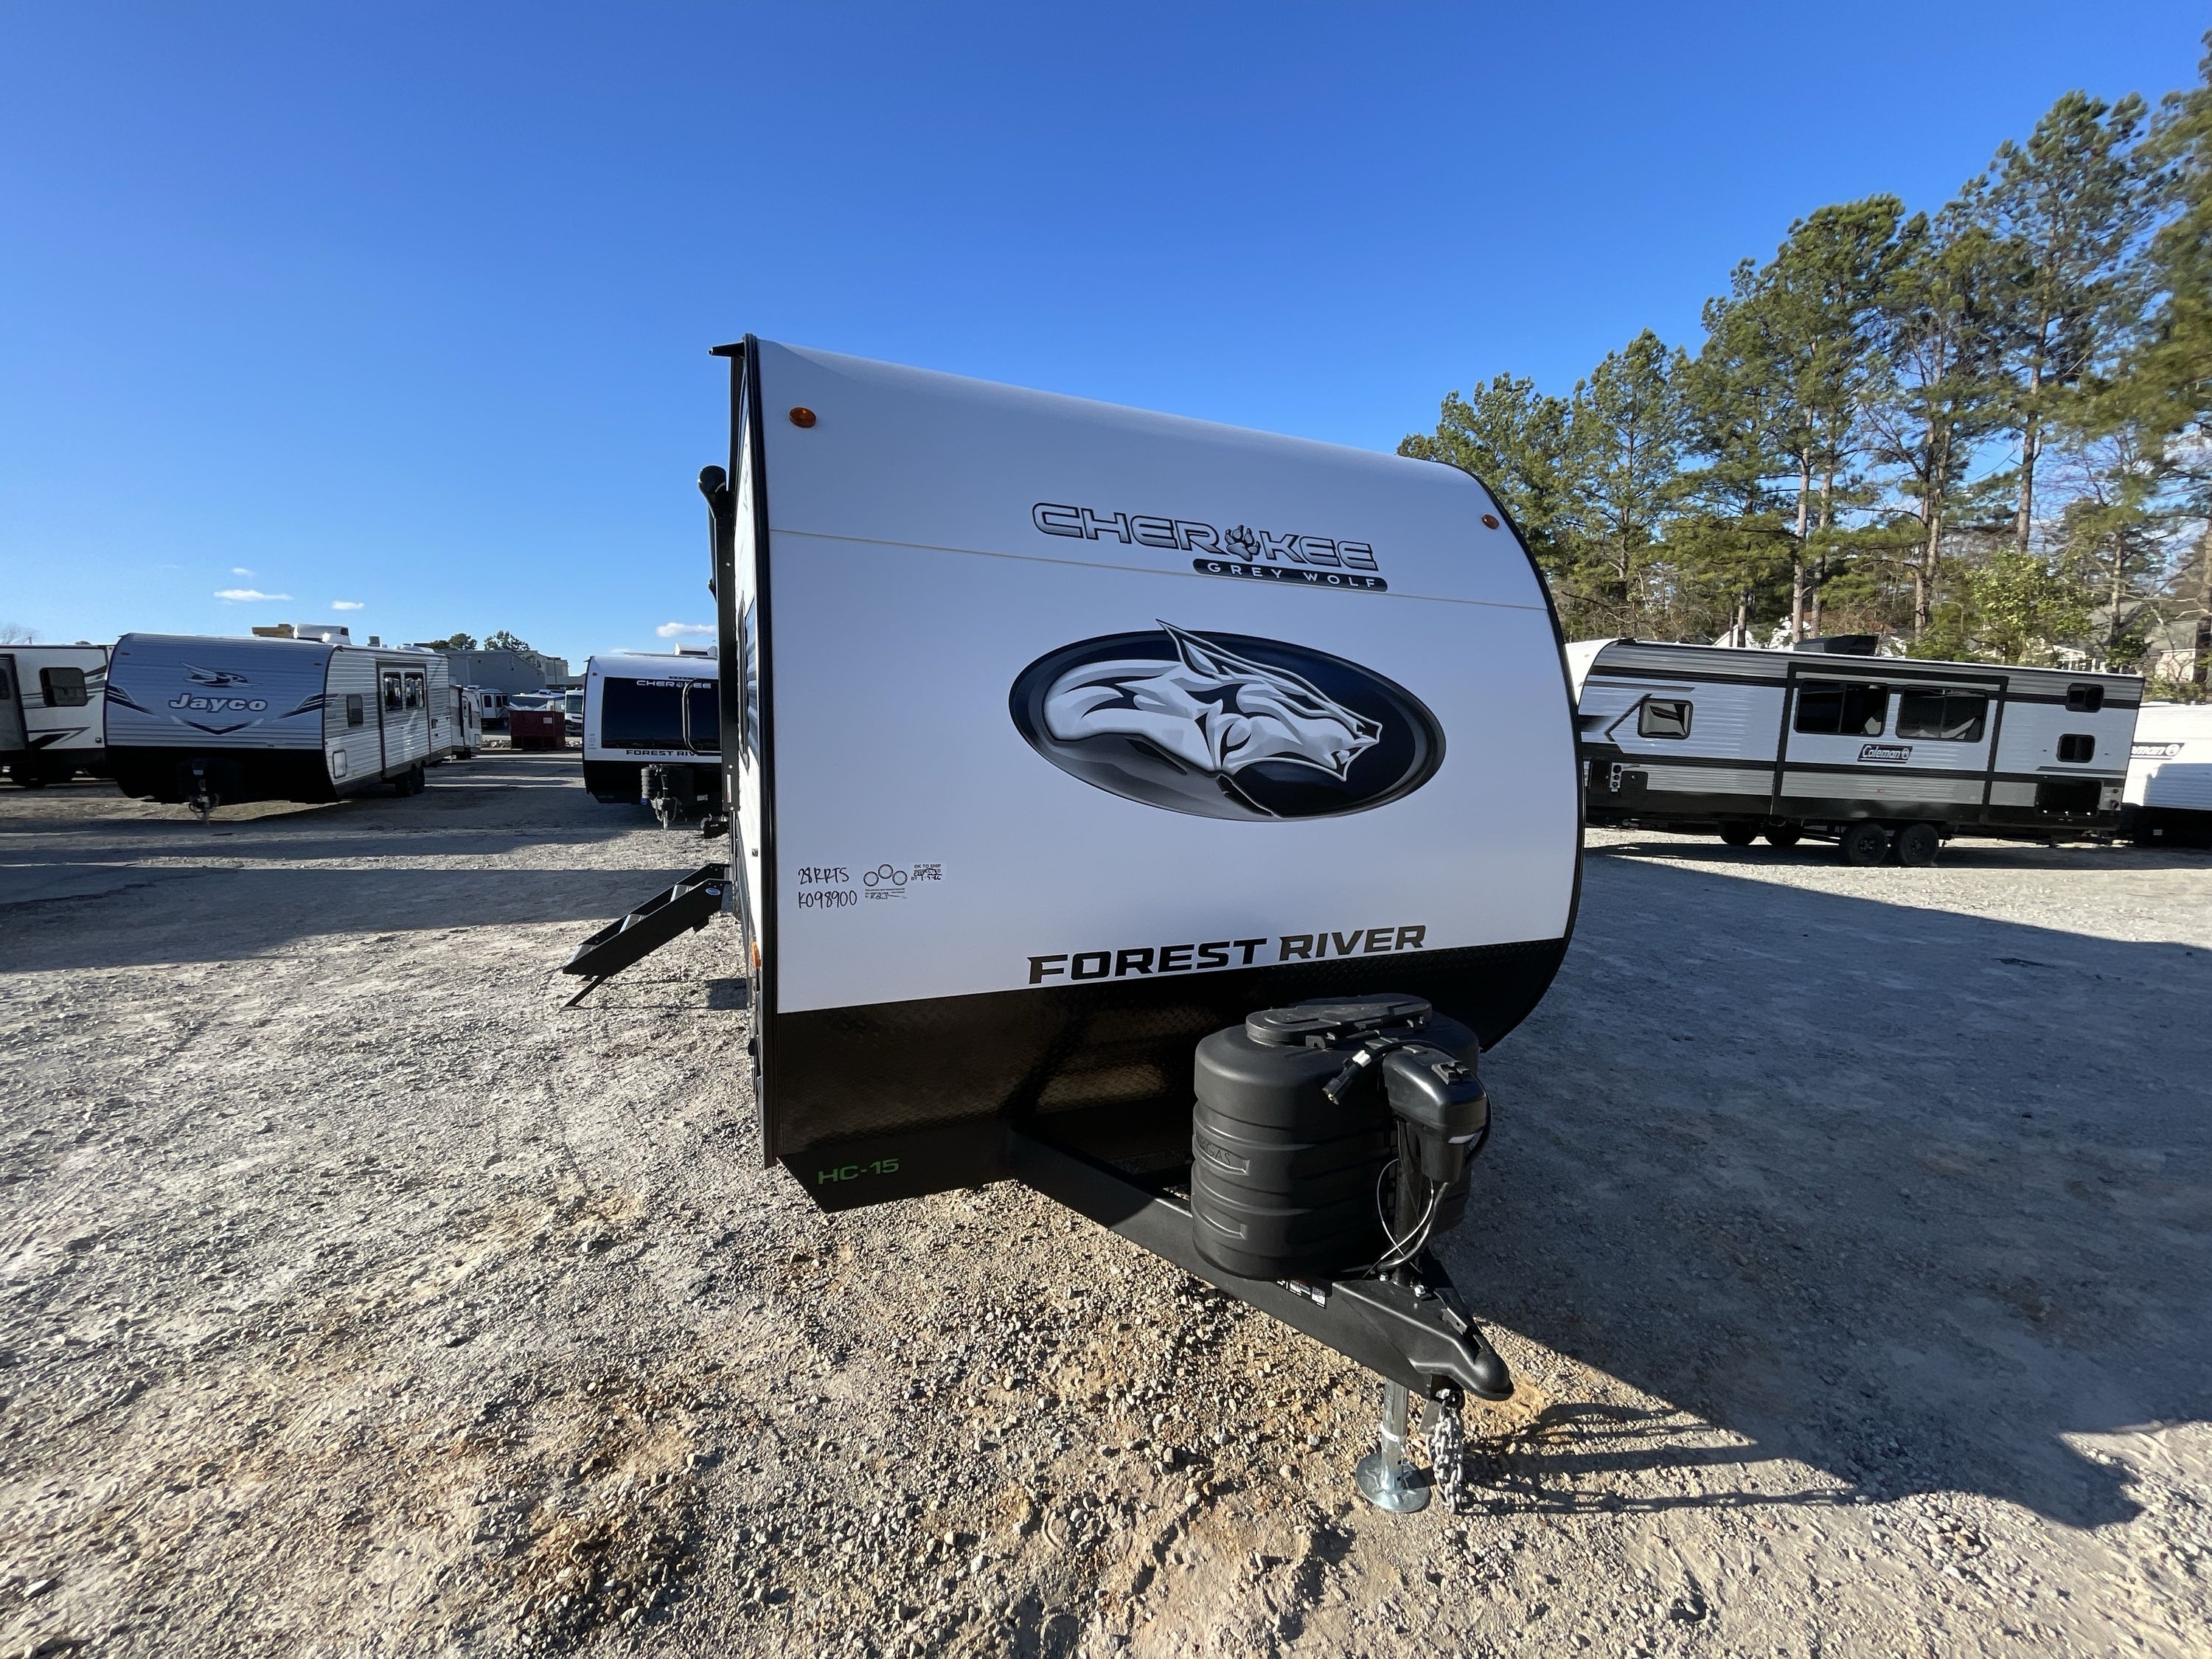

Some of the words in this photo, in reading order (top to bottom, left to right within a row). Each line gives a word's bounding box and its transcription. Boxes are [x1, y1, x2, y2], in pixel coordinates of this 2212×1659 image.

[1207, 563, 1283, 579] GREY
[1302, 572, 1376, 588] WOLF
[168, 692, 268, 713] Jayco
[1863, 745, 1900, 759] Coleman
[798, 866, 849, 885] 28RRTS
[798, 890, 858, 909] K098900
[1026, 937, 1268, 985] FOREST
[1279, 925, 1427, 961] RIVER
[818, 1158, 900, 1185] HC-15
